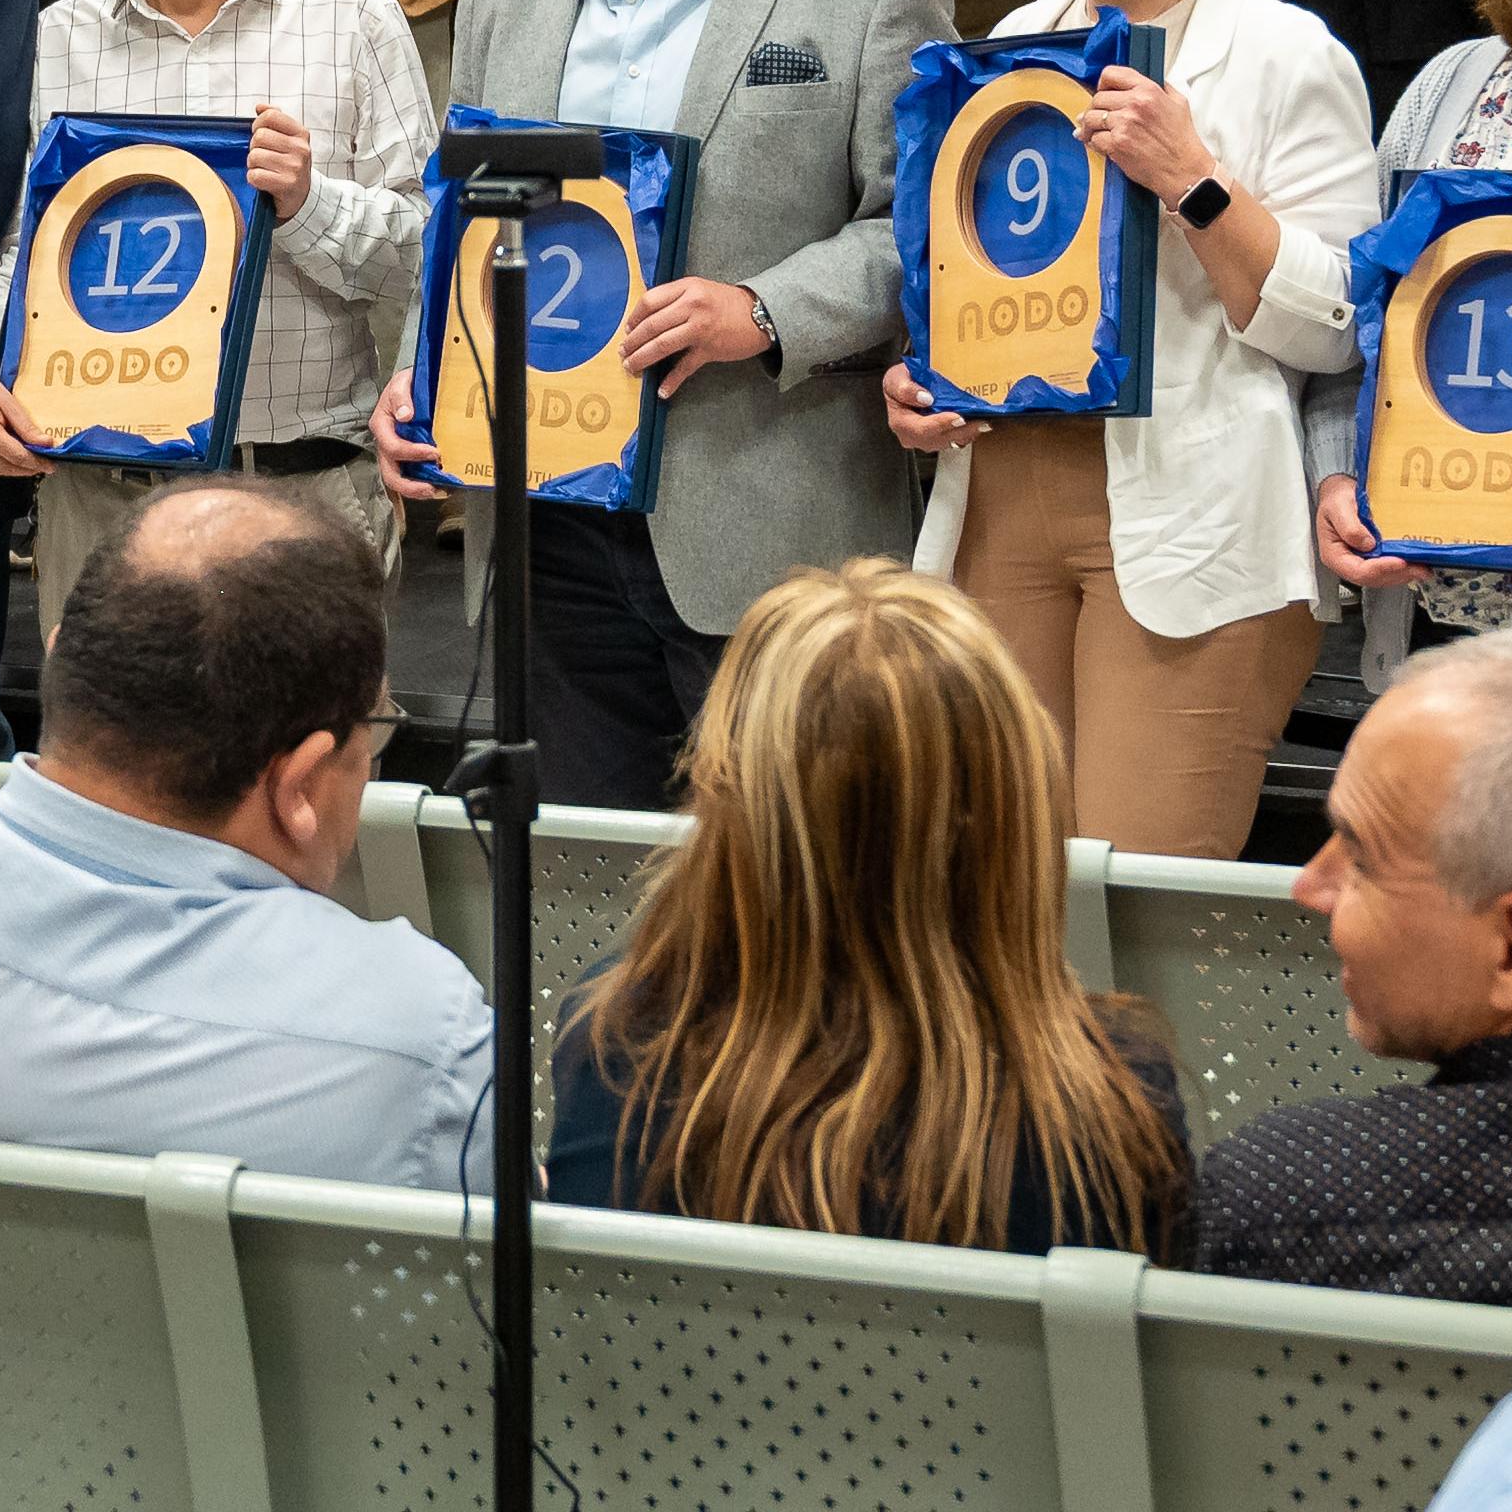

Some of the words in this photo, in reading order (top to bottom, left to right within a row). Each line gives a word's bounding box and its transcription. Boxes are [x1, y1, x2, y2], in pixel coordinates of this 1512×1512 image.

[1007, 148, 1049, 236] 9
[87, 217, 182, 297] 12
[530, 244, 583, 330] 2
[958, 284, 1089, 343] NODO
[44, 345, 190, 387] NODO
[465, 382, 612, 433] NDO
[464, 463, 494, 477] ANE
